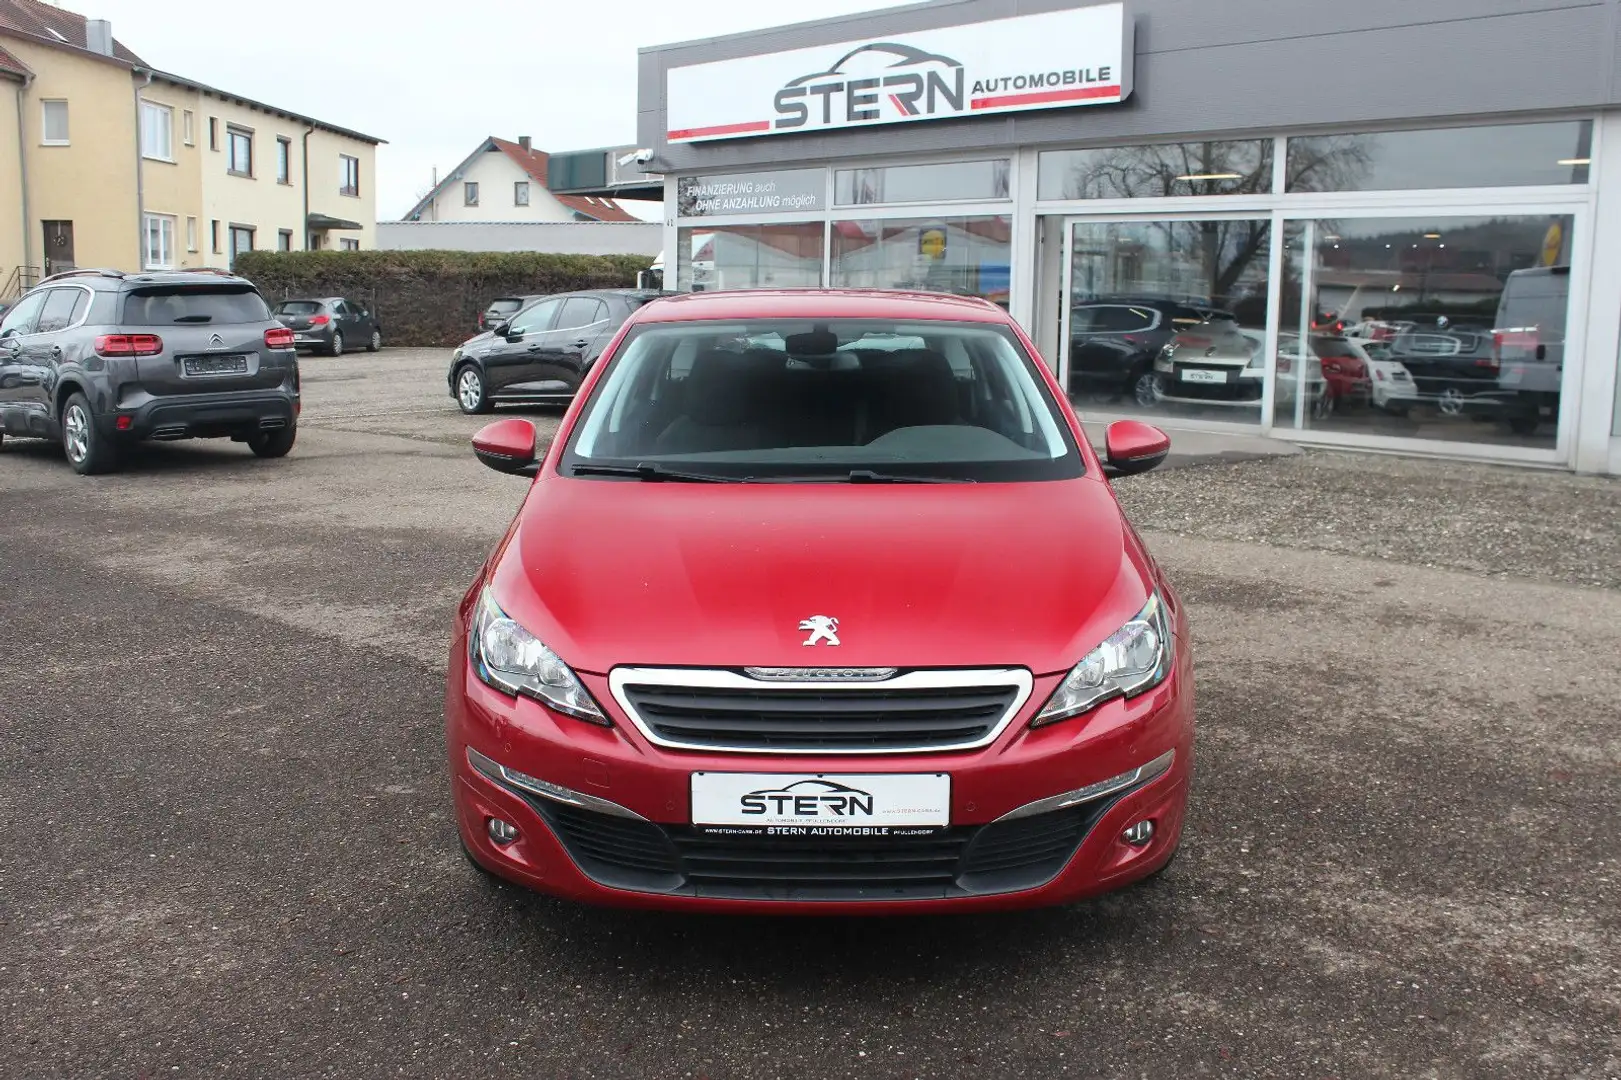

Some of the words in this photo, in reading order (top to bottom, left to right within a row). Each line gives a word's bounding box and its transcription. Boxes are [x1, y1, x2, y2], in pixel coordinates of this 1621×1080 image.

[773, 67, 964, 129] STERN
[971, 67, 1111, 95] AUTOMOBILE
[686, 183, 753, 197] FINANZIERUNG
[754, 181, 776, 193] auch
[695, 199, 722, 211] OHNE
[722, 195, 781, 210] ANZAHLUNG
[781, 193, 816, 209] möglich
[740, 795, 873, 816] STERN
[767, 826, 806, 835] STERN
[811, 827, 888, 836] AUTOMOBILE
